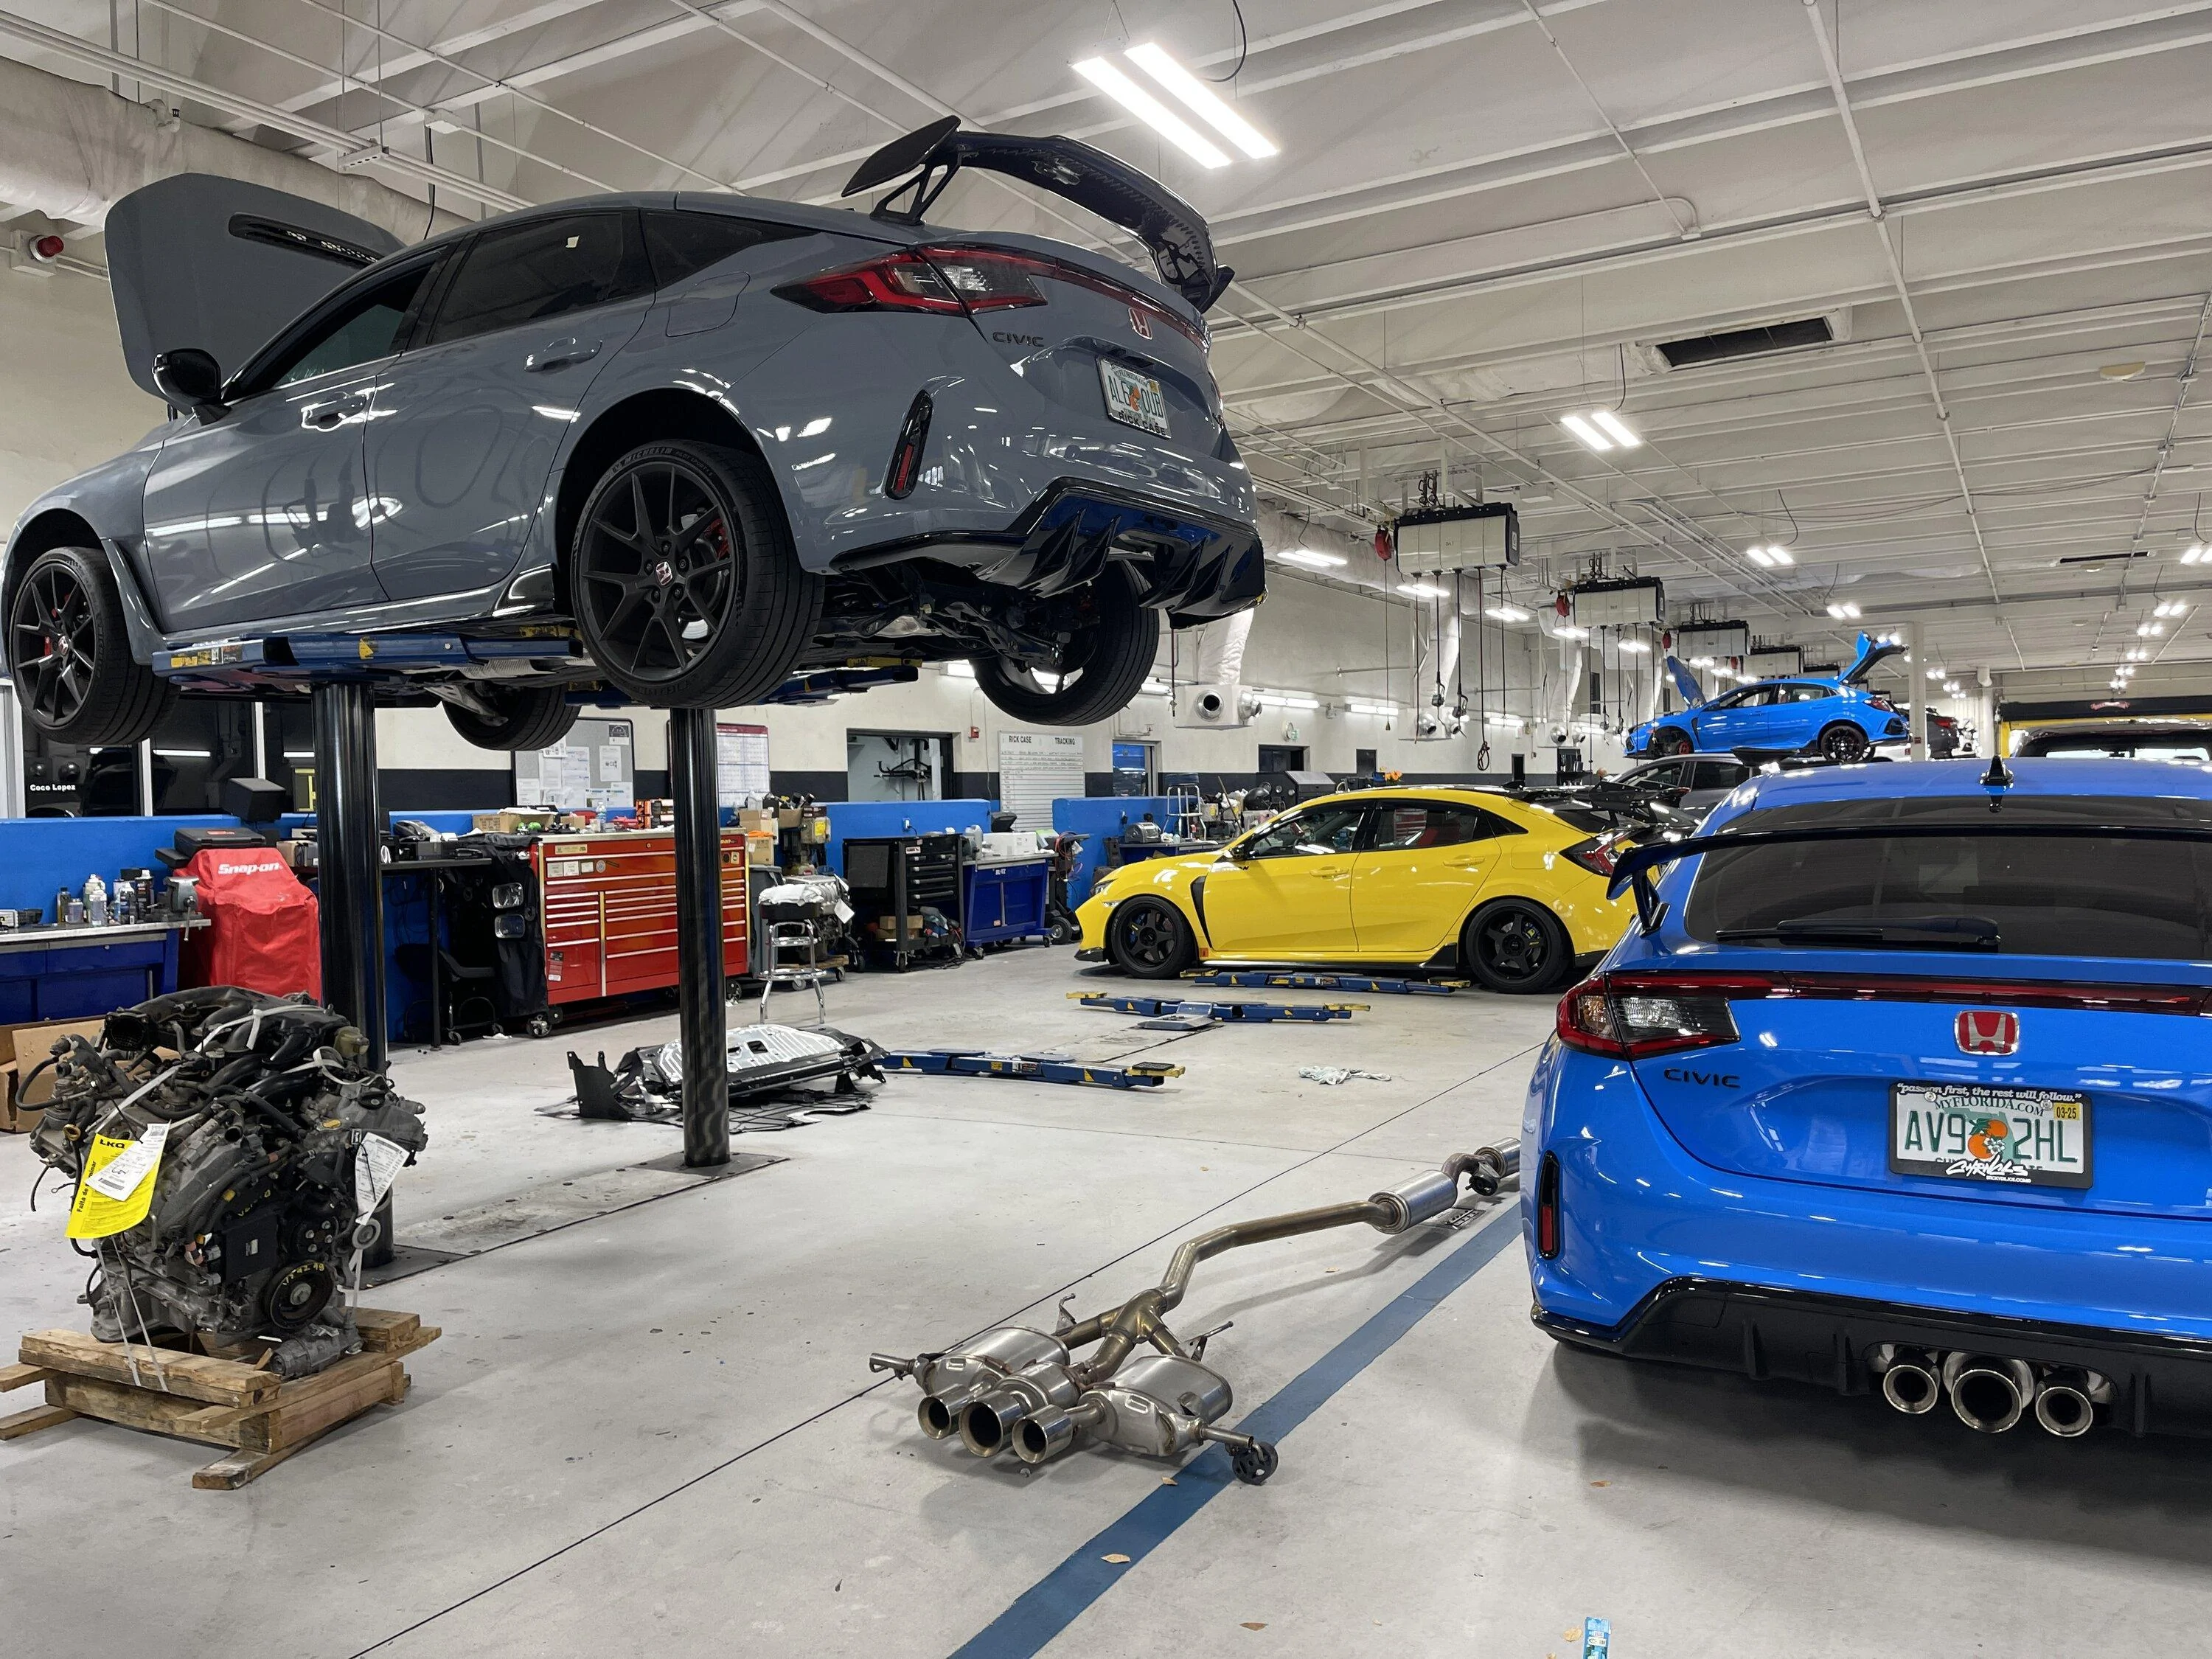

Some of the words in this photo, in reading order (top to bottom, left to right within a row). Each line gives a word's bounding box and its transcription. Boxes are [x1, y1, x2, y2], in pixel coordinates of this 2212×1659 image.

[992, 331, 1044, 347] CIVIC
[1119, 411, 1141, 427] RICK
[1142, 420, 1166, 436] CASE
[1009, 735, 1020, 743] RICK
[1020, 736, 1032, 744] CASE
[1054, 737, 1076, 745] TRACKING
[29, 784, 51, 792] Coco
[52, 783, 76, 793] Lopez
[218, 862, 280, 875] Snap-on
[1663, 1068, 1742, 1089] CIVIC
[1972, 1087, 1991, 1096] the
[1992, 1088, 2014, 1098] rest
[2015, 1090, 2037, 1099] will
[1934, 1095, 2045, 1117] MYFLORIDA.COM
[2056, 1106, 2077, 1119] 03-25
[99, 1138, 125, 1149] LKQ
[1905, 1110, 1966, 1155] AV9
[2011, 1117, 2079, 1164] 2HL
[77, 1195, 86, 1213] Falta
[83, 1186, 89, 1196] de
